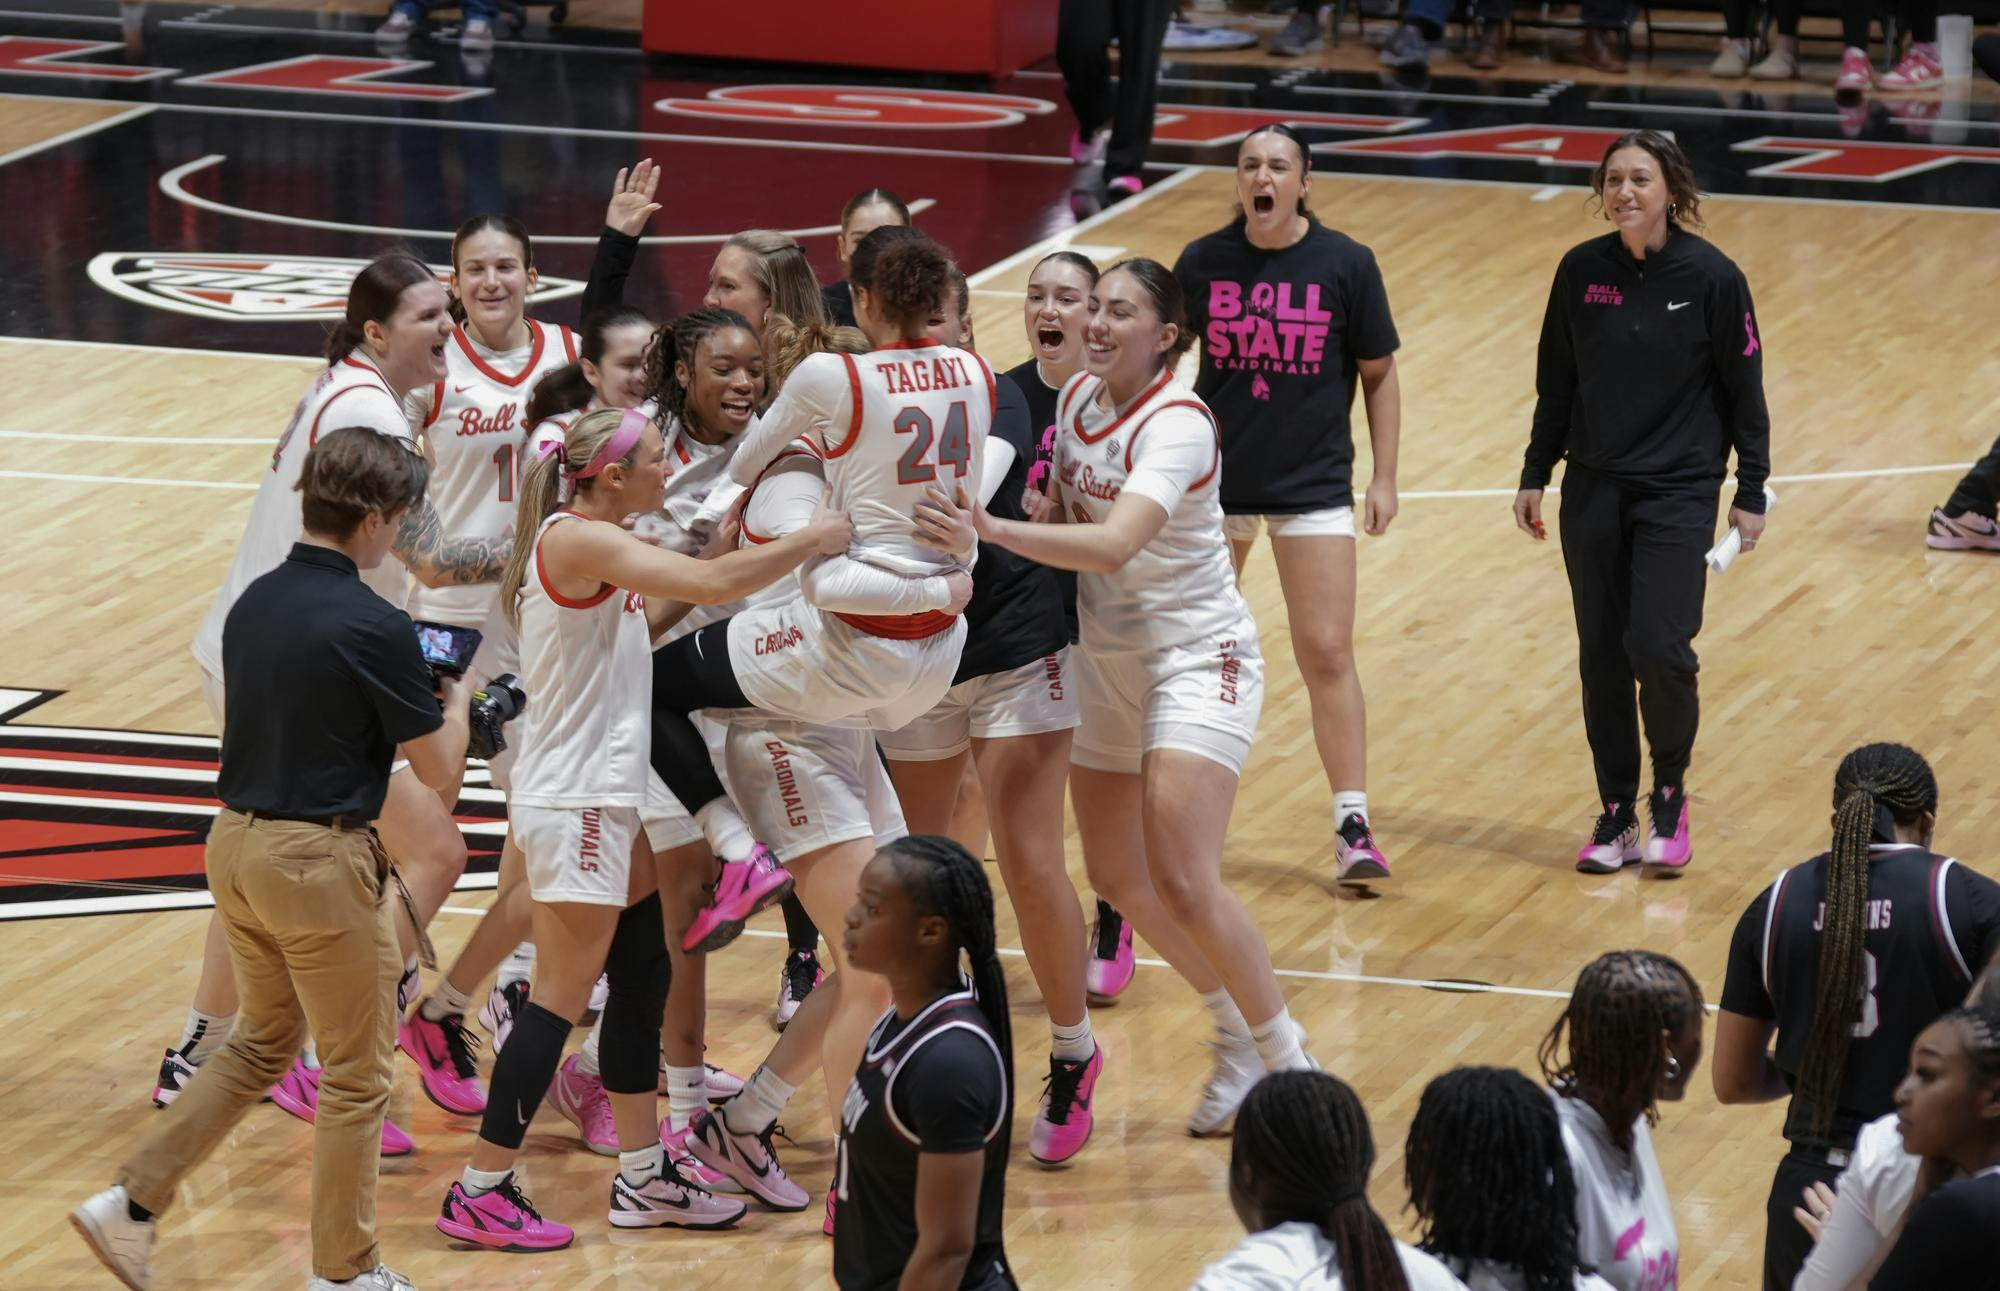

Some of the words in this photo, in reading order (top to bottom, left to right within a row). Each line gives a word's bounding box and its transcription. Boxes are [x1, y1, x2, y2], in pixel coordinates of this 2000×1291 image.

[1583, 293, 1624, 305] STATE
[1586, 283, 1620, 295] BALL
[1206, 315, 1330, 362] STATE
[876, 356, 972, 394] TAGAYI
[1214, 358, 1321, 375] CARDINALS
[456, 402, 517, 436] Ball
[893, 400, 972, 485] 24
[765, 741, 808, 827] CARDINALS
